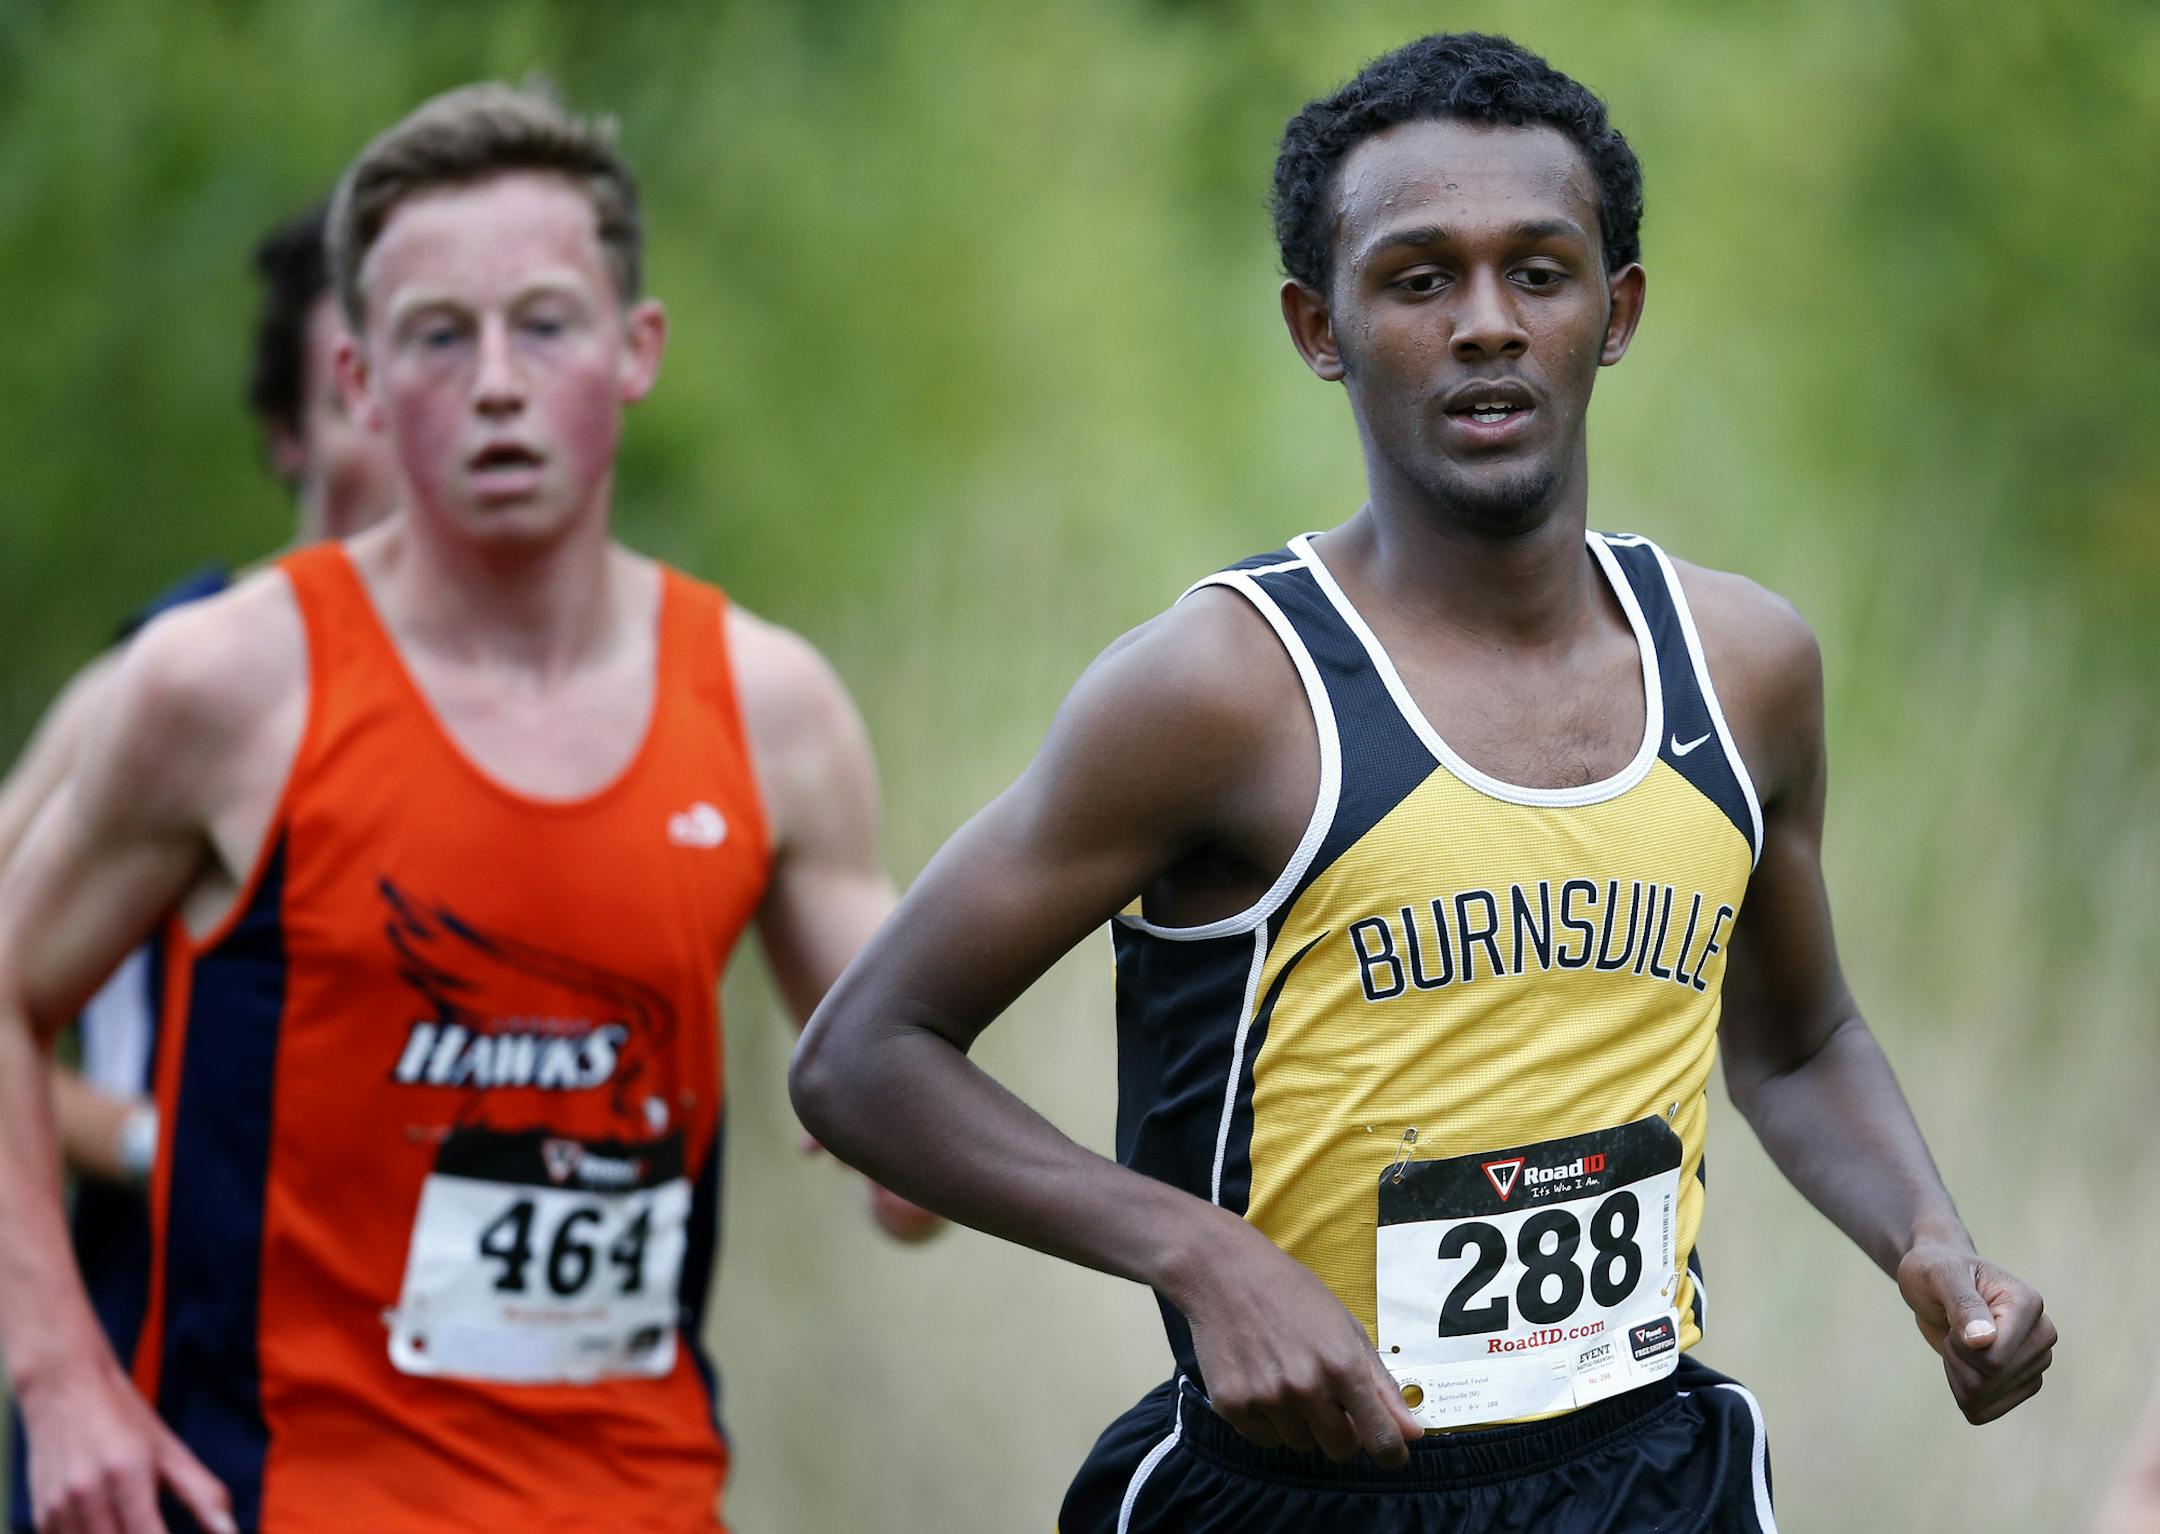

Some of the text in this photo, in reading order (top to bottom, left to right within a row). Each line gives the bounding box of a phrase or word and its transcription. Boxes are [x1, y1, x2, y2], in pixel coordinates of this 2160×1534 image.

[1349, 878, 1733, 1003] BURNSVILLE
[394, 1020, 630, 1090] HAWKS
[1524, 1152, 1606, 1186] RoadID
[1531, 1184, 1551, 1198] It's
[1553, 1182, 1572, 1194] Who
[1575, 1178, 1583, 1190] I
[479, 1198, 652, 1296] 464
[1437, 1190, 1643, 1338] 288
[1487, 1320, 1605, 1354] RoadID.com
[1579, 1343, 1611, 1363] EVENT
